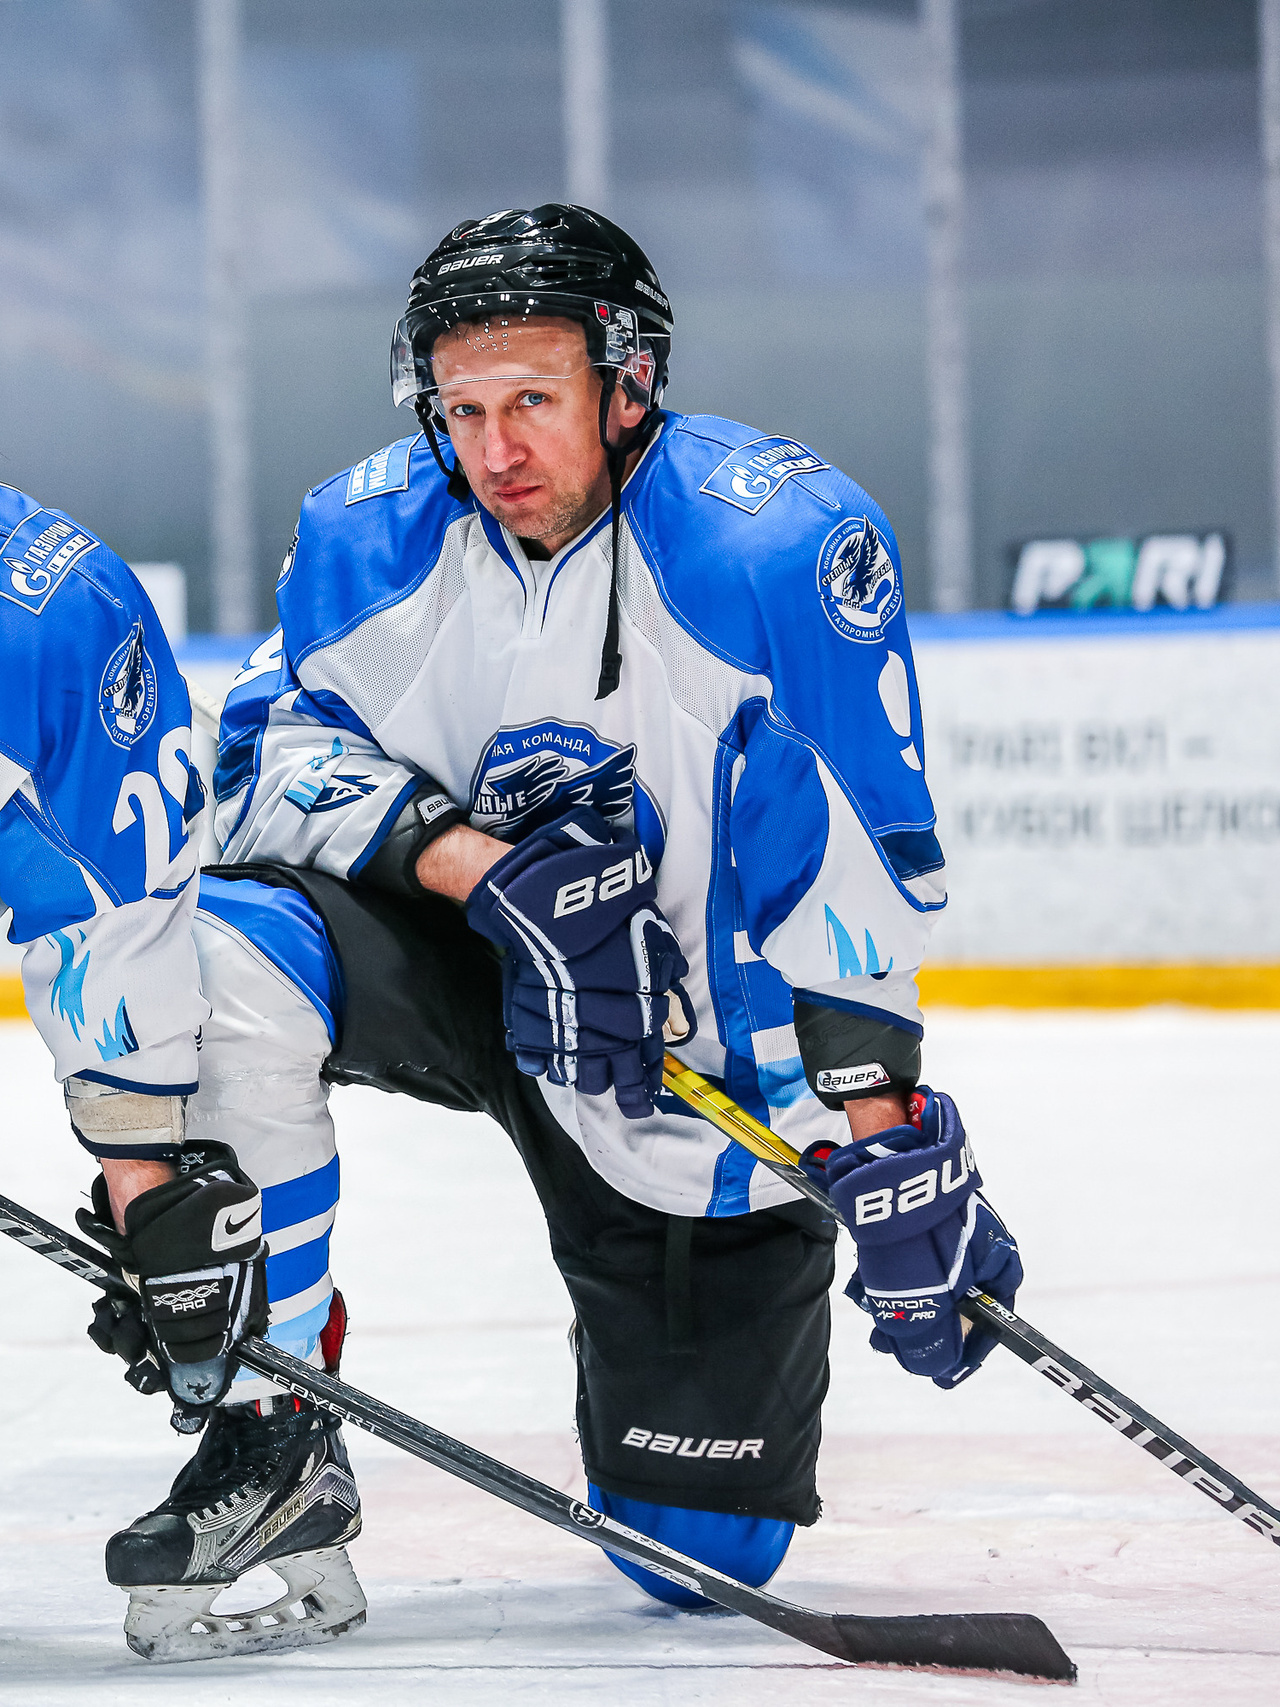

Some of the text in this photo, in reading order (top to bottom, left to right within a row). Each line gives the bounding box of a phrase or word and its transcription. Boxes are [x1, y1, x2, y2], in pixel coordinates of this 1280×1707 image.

[437, 254, 505, 276] BAUER
[746, 443, 807, 472] ГАЗПРОМ
[23, 521, 75, 566] ГАЗПРОМ
[522, 731, 592, 756] КОМАНДА
[426, 797, 450, 814] BAU
[553, 844, 653, 919] BAU
[822, 1070, 878, 1087] BAUER
[855, 1137, 975, 1226] BAU
[172, 1298, 207, 1314] PRO
[871, 1298, 941, 1310] VAPOR
[909, 1310, 936, 1322] PRO
[272, 1373, 382, 1433] COVERT
[622, 1427, 765, 1460] BAUER
[1031, 1355, 1280, 1546] BAUER
